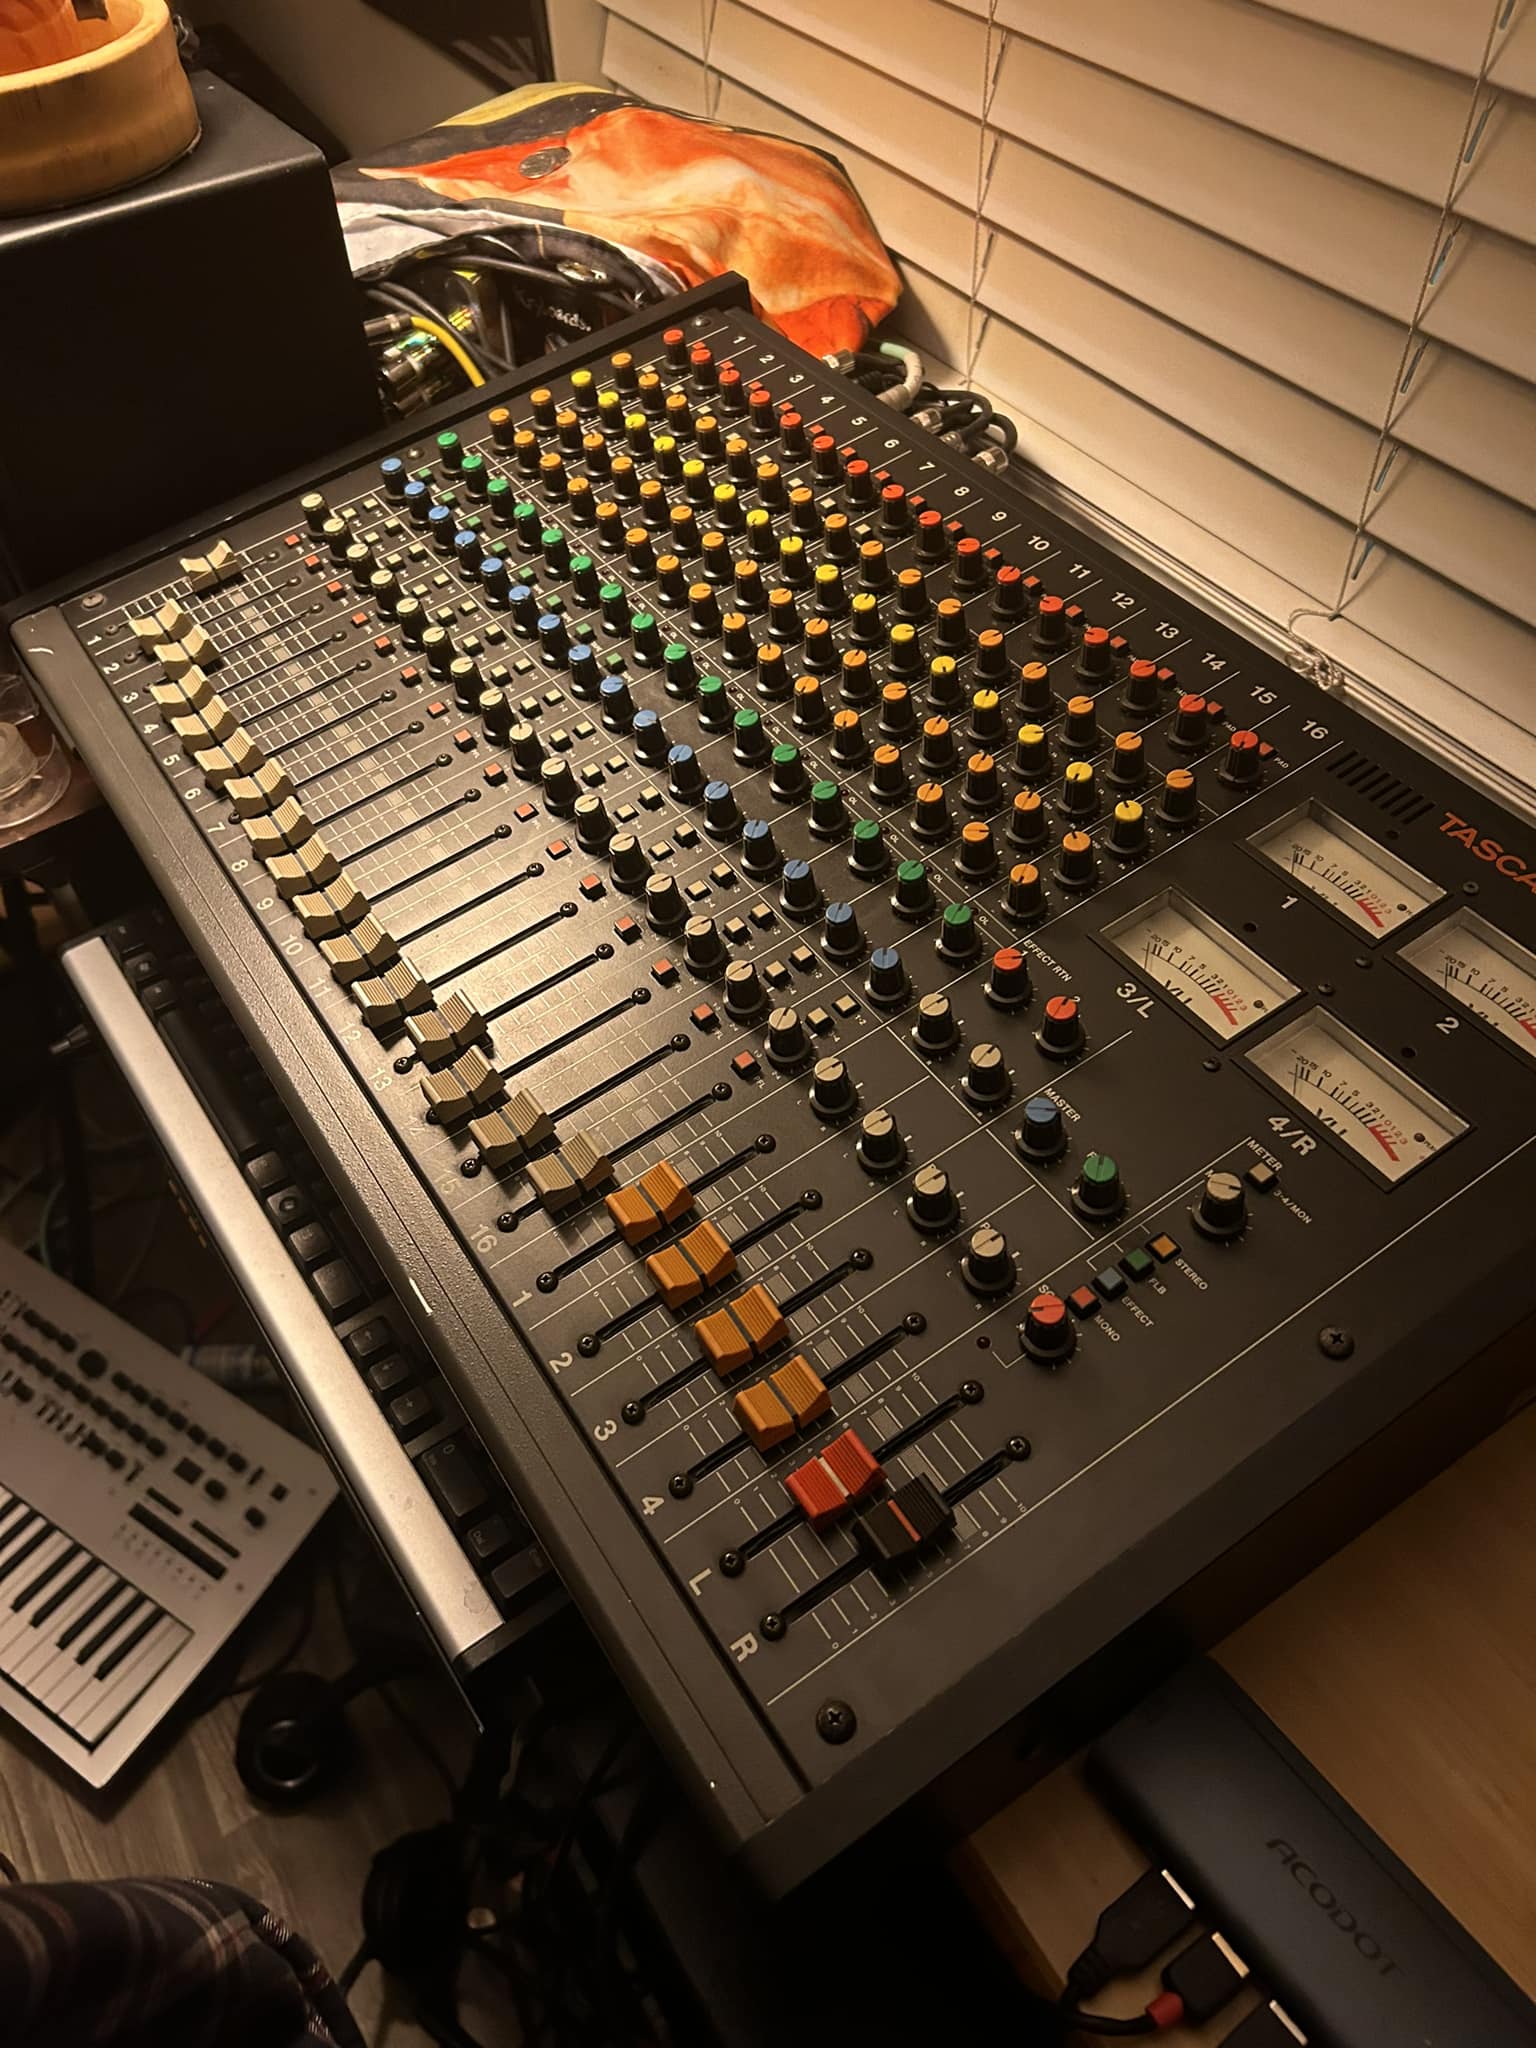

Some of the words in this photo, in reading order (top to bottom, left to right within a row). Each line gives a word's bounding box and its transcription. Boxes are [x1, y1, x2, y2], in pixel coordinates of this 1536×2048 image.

[732, 335, 746, 344] 1
[759, 354, 775, 364] 2
[789, 374, 804, 383] 3
[820, 395, 835, 404] 4
[851, 416, 868, 426] 5
[884, 439, 899, 449] 6
[917, 461, 936, 472] 7
[953, 486, 970, 497] 8
[991, 511, 1007, 521] 9
[1027, 535, 1050, 551] 10
[1069, 563, 1092, 579] 11
[1110, 591, 1135, 609] 12
[1154, 621, 1180, 640] 13
[1200, 652, 1227, 671] 14
[1250, 685, 1278, 704] 15
[1301, 719, 1329, 740] 16
[1274, 756, 1289, 770] PAD
[1281, 895, 1298, 909] 1
[87, 635, 102, 646] 1
[103, 662, 120, 675] 2
[123, 692, 138, 705] 3
[143, 722, 160, 735] 4
[162, 753, 181, 767] 5
[184, 788, 201, 801] 6
[207, 821, 226, 836] 7
[231, 859, 249, 873] 8
[256, 897, 274, 911] 9
[280, 933, 303, 956] 10
[309, 977, 333, 999] 11
[368, 1066, 393, 1092] 13
[470, 1223, 497, 1253] 16
[1023, 939, 1055, 967] EFFECT
[1052, 965, 1072, 982] RTN
[1116, 981, 1154, 1019] 3/L
[1436, 1016, 1459, 1034] 2
[1043, 1088, 1081, 1122] MASTER
[1267, 1115, 1317, 1156] 4/R
[1247, 1140, 1283, 1172] METER
[1174, 1258, 1209, 1291] STEREO
[1094, 1315, 1120, 1342] MONO
[1122, 1296, 1154, 1328] EFFECT
[512, 1291, 532, 1308] 1
[550, 1352, 573, 1375] 2
[593, 1419, 618, 1442] 3
[641, 1495, 665, 1516] 4
[688, 1568, 713, 1597] L
[729, 1631, 759, 1662] R
[1266, 1838, 1402, 1976] ACODOT
